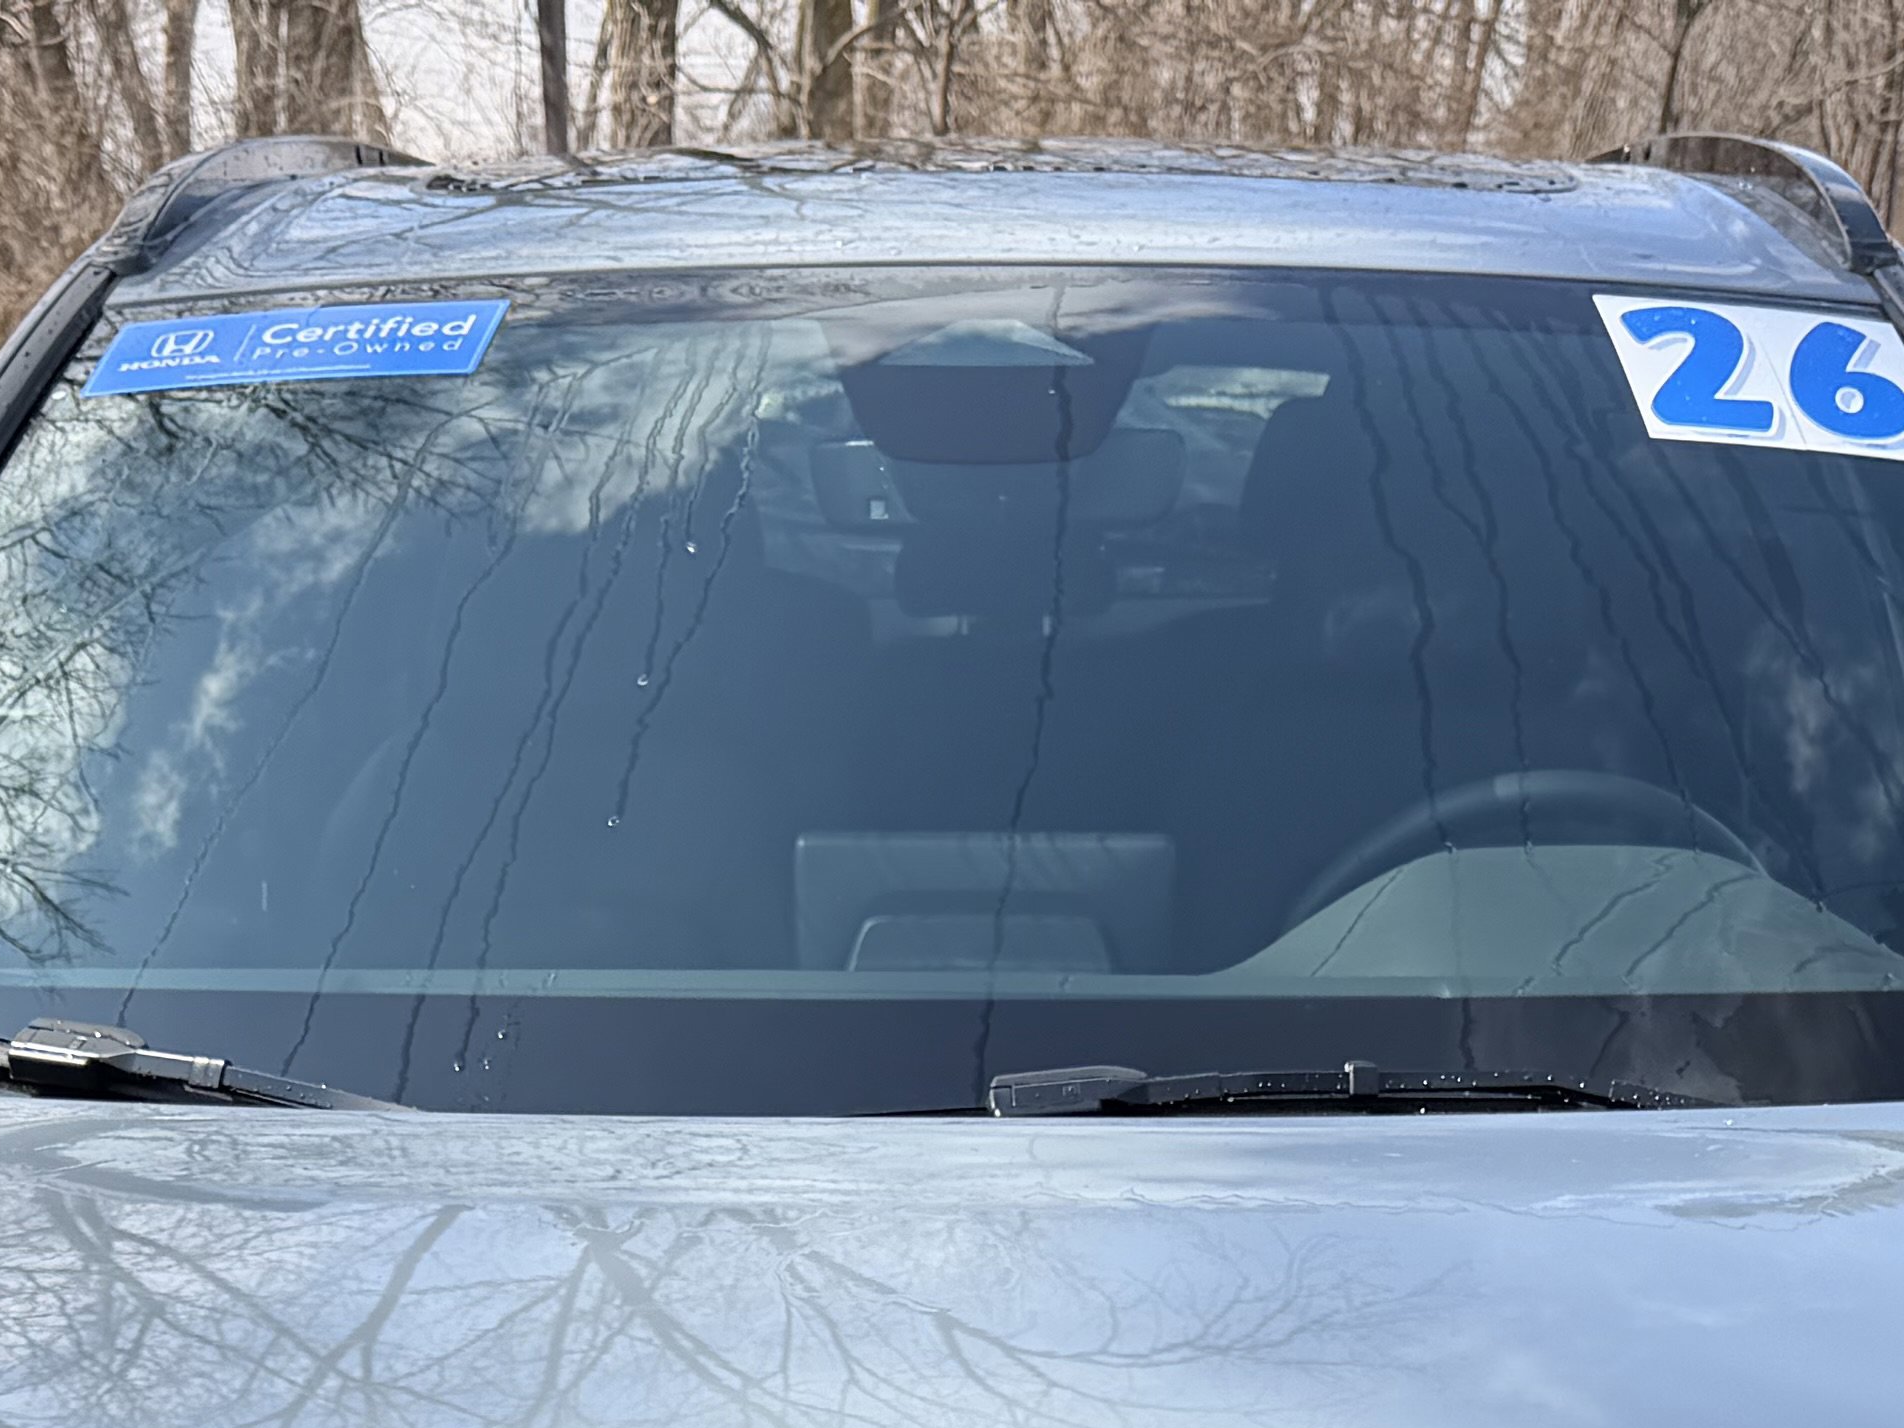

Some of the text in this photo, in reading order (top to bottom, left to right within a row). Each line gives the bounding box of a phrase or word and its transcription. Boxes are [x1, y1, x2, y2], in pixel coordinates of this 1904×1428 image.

[261, 314, 477, 345] Certified
[251, 337, 465, 360] Pre-Owned
[118, 354, 221, 372] HONDA
